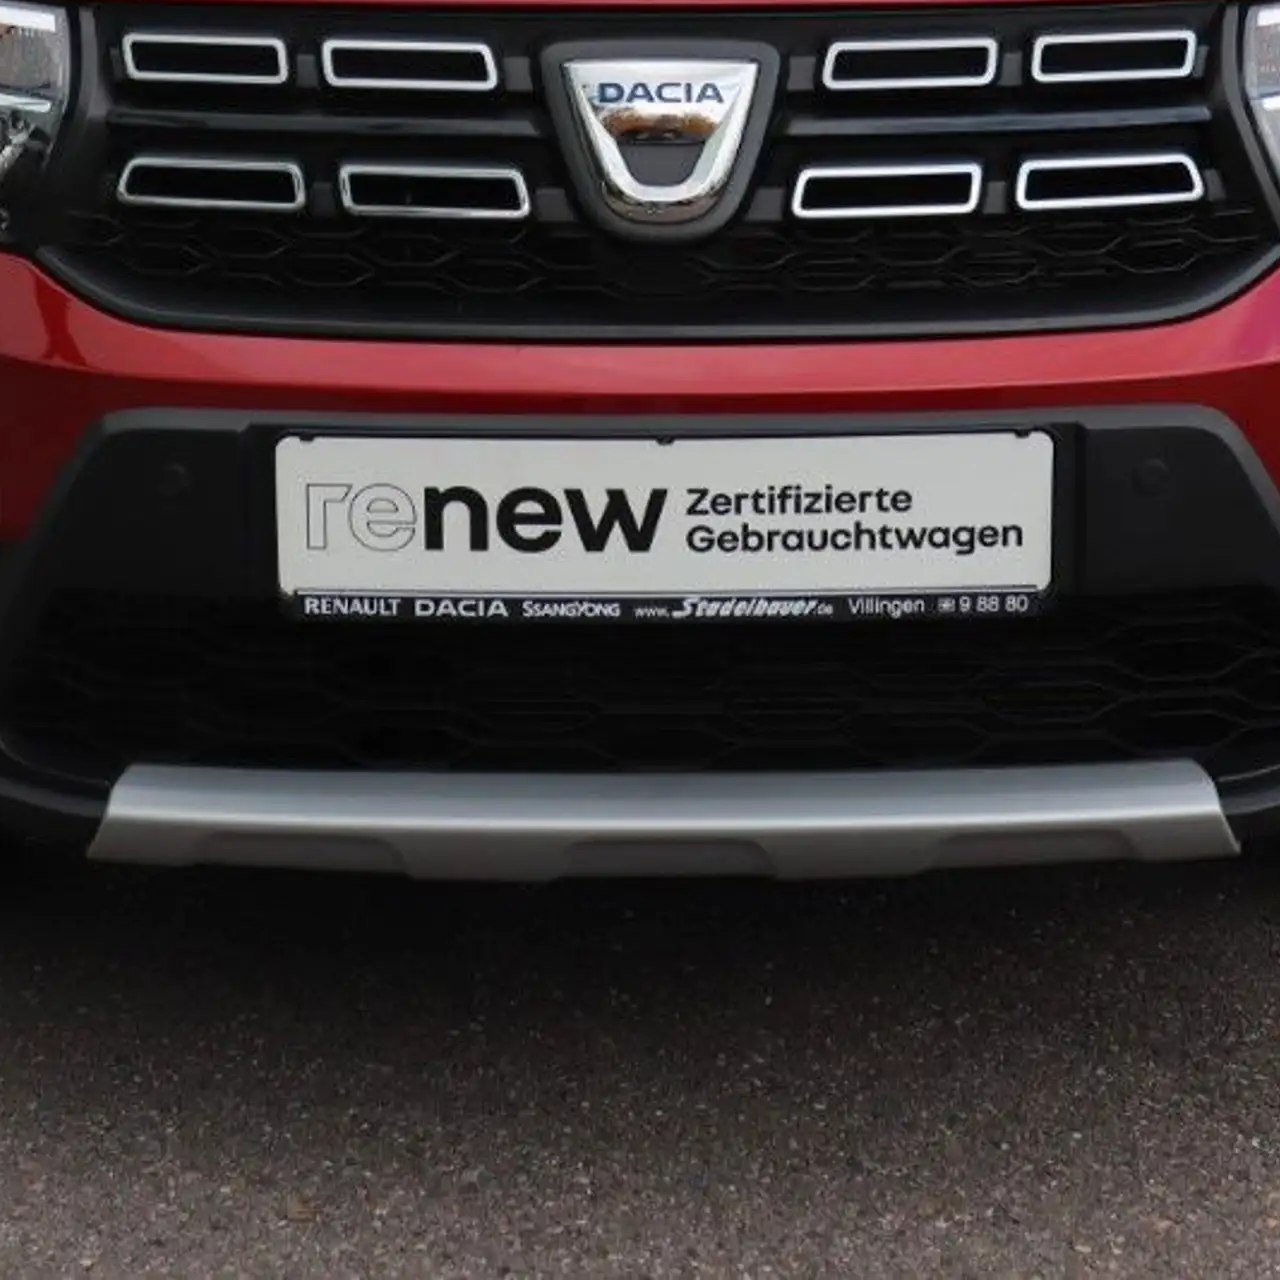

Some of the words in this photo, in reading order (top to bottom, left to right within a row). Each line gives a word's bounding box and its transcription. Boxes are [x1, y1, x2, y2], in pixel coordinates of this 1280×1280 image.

[597, 81, 725, 104] DACIA
[686, 485, 913, 516] Zertifizierte
[306, 483, 668, 552] renew
[686, 521, 1023, 555] Gebrauchtwagen
[304, 597, 401, 616] RENAULT
[415, 599, 508, 617] DACIA
[848, 596, 925, 618] Villingen
